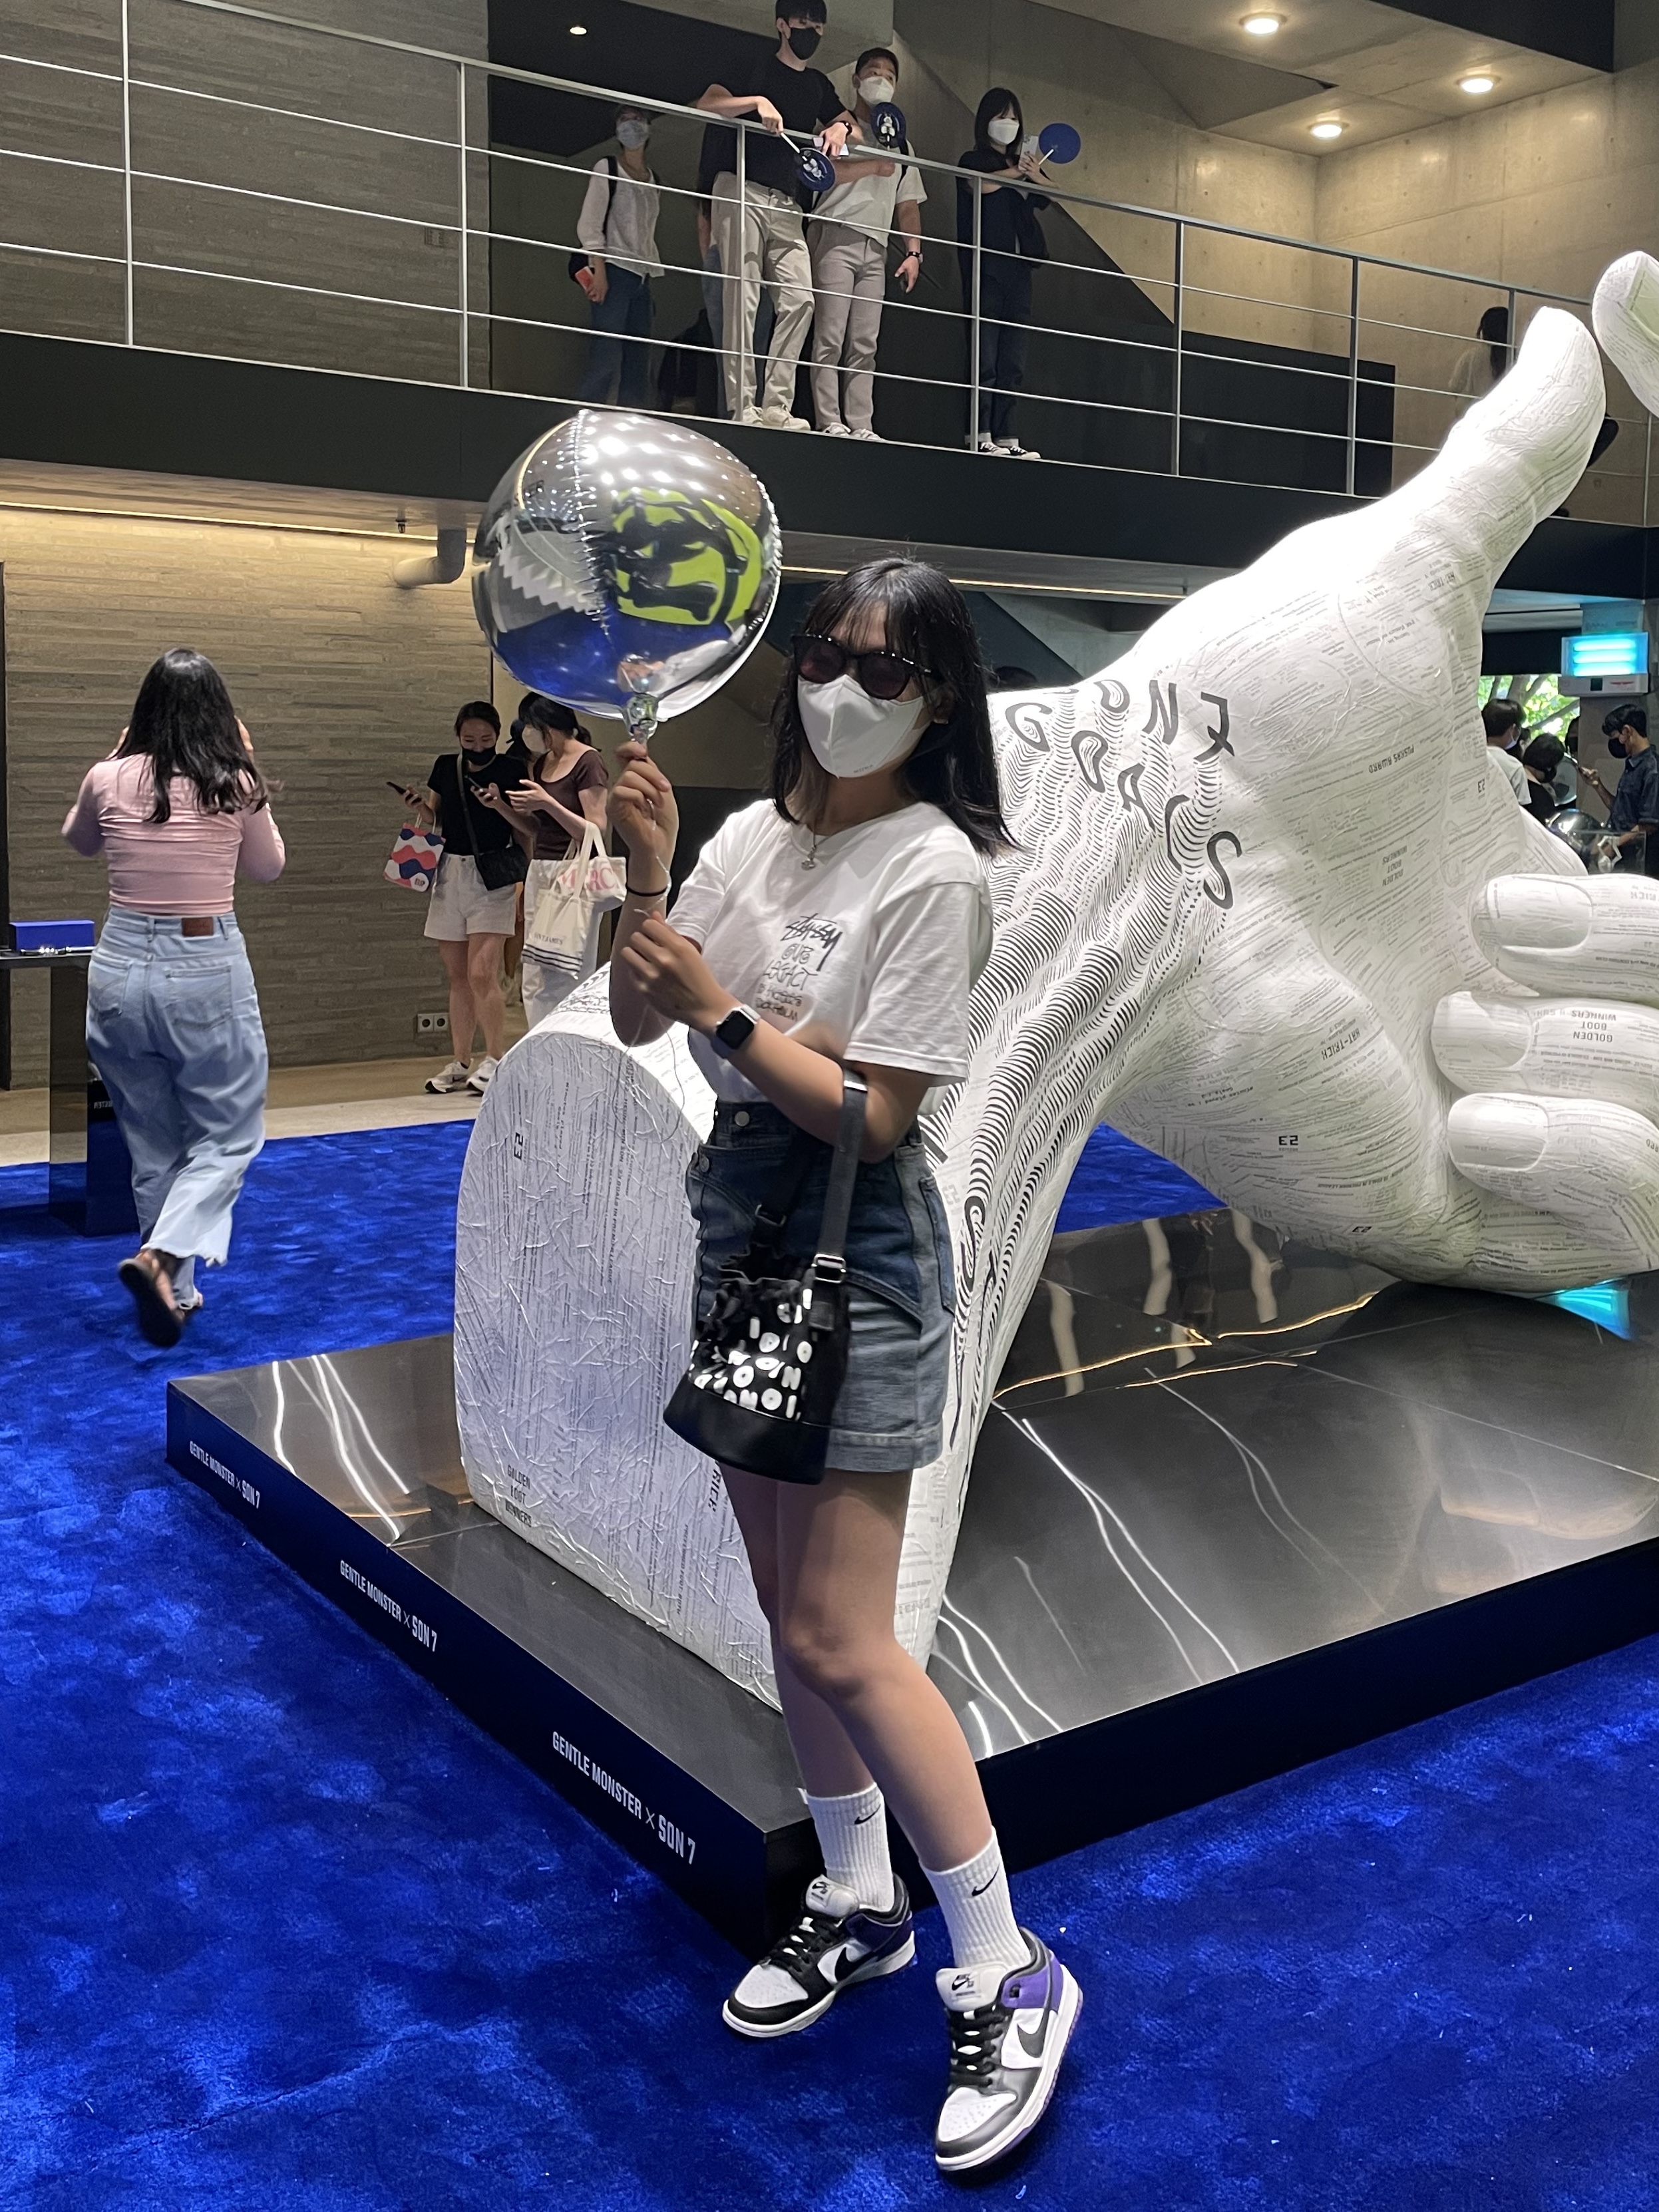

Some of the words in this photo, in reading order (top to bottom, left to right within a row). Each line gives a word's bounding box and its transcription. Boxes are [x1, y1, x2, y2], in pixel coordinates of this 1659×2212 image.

[1571, 1010, 1616, 1021] WINNERS
[1580, 1021, 1607, 1031] BOOT
[1321, 1027, 1361, 1060] HAT-TRICK
[1572, 1030, 1613, 1043] GOLDEN
[513, 1132, 524, 1161] 23
[1278, 1135, 1299, 1145] 23
[1646, 1139, 1659, 1153] ARD
[190, 1440, 209, 1467] GENTLE
[209, 1455, 236, 1489] MONSTER
[242, 1479, 255, 1507] SON
[255, 1490, 260, 1509] 7
[707, 1469, 721, 1513] RICK
[339, 1560, 366, 1593] GENTLE
[366, 1580, 402, 1622] MONSTER
[411, 1615, 431, 1648] SON
[431, 1629, 438, 1652] 7
[552, 1731, 590, 1777] GENTLE
[592, 1761, 642, 1820] MONSTER
[658, 1814, 685, 1858] SON
[687, 1837, 696, 1865] 7
